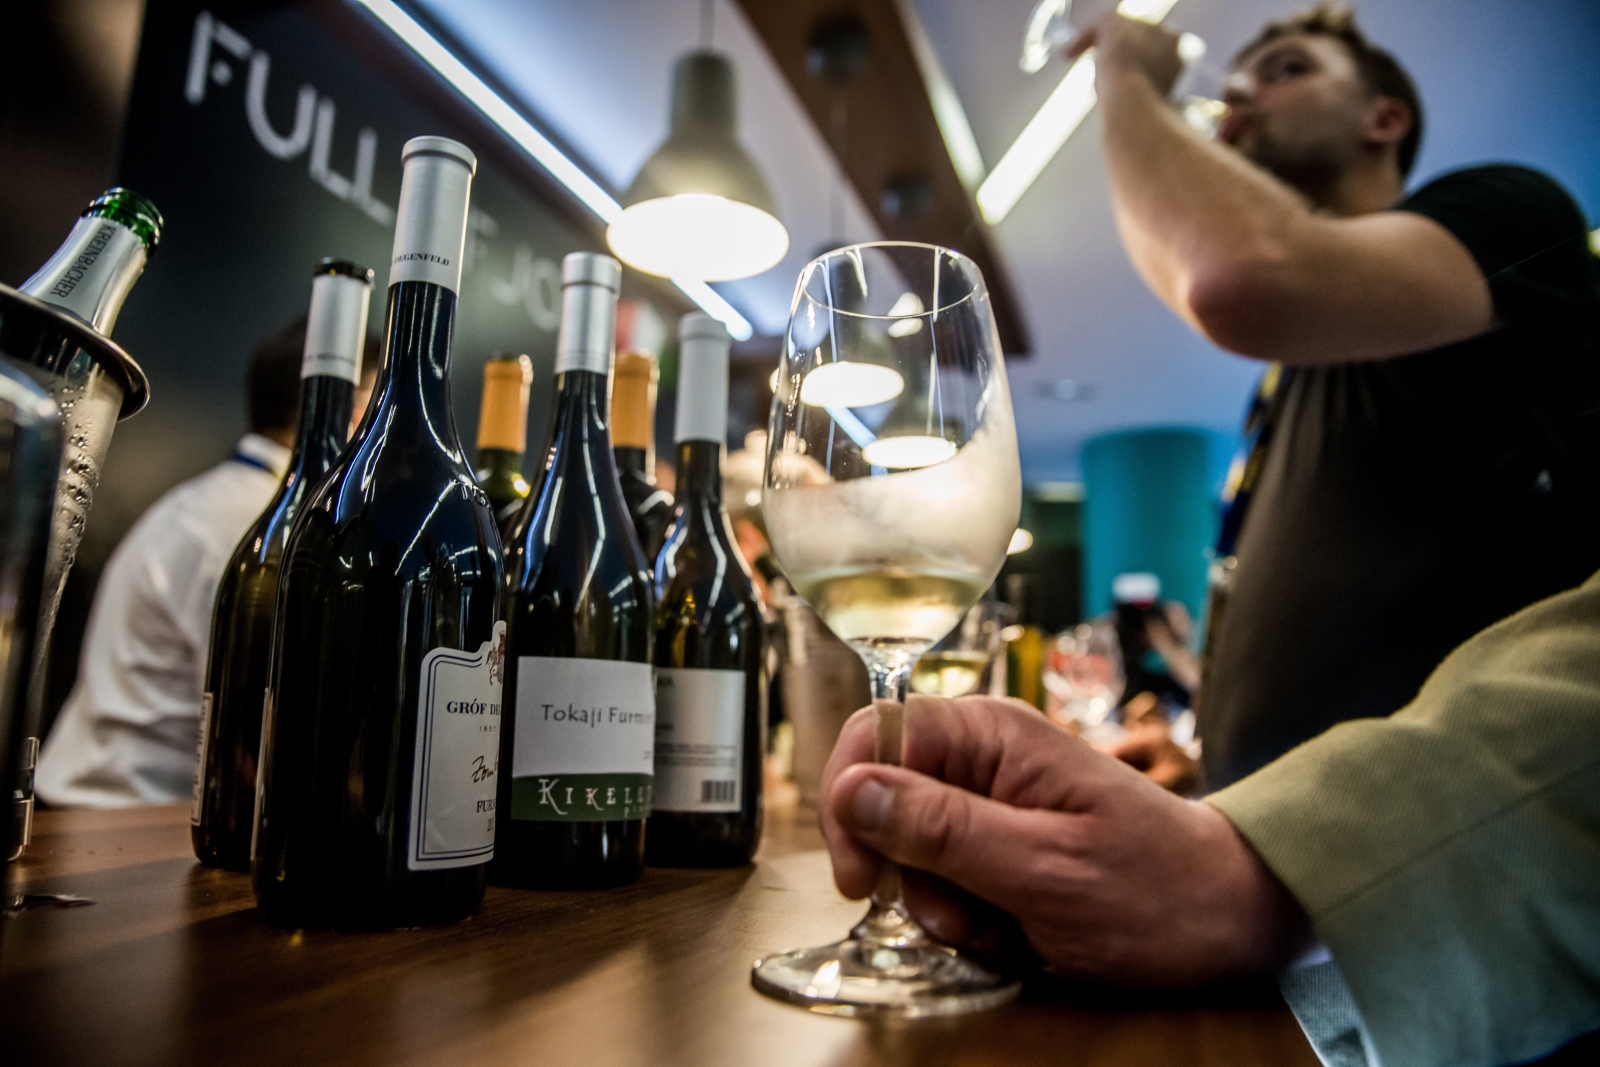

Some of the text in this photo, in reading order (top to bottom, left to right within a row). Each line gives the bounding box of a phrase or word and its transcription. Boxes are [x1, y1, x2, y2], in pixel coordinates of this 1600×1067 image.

[186, 9, 395, 226] FULL
[50, 223, 117, 298] KREINBACHER
[446, 698, 487, 715] GRÓF
[541, 704, 602, 729] Tokaji
